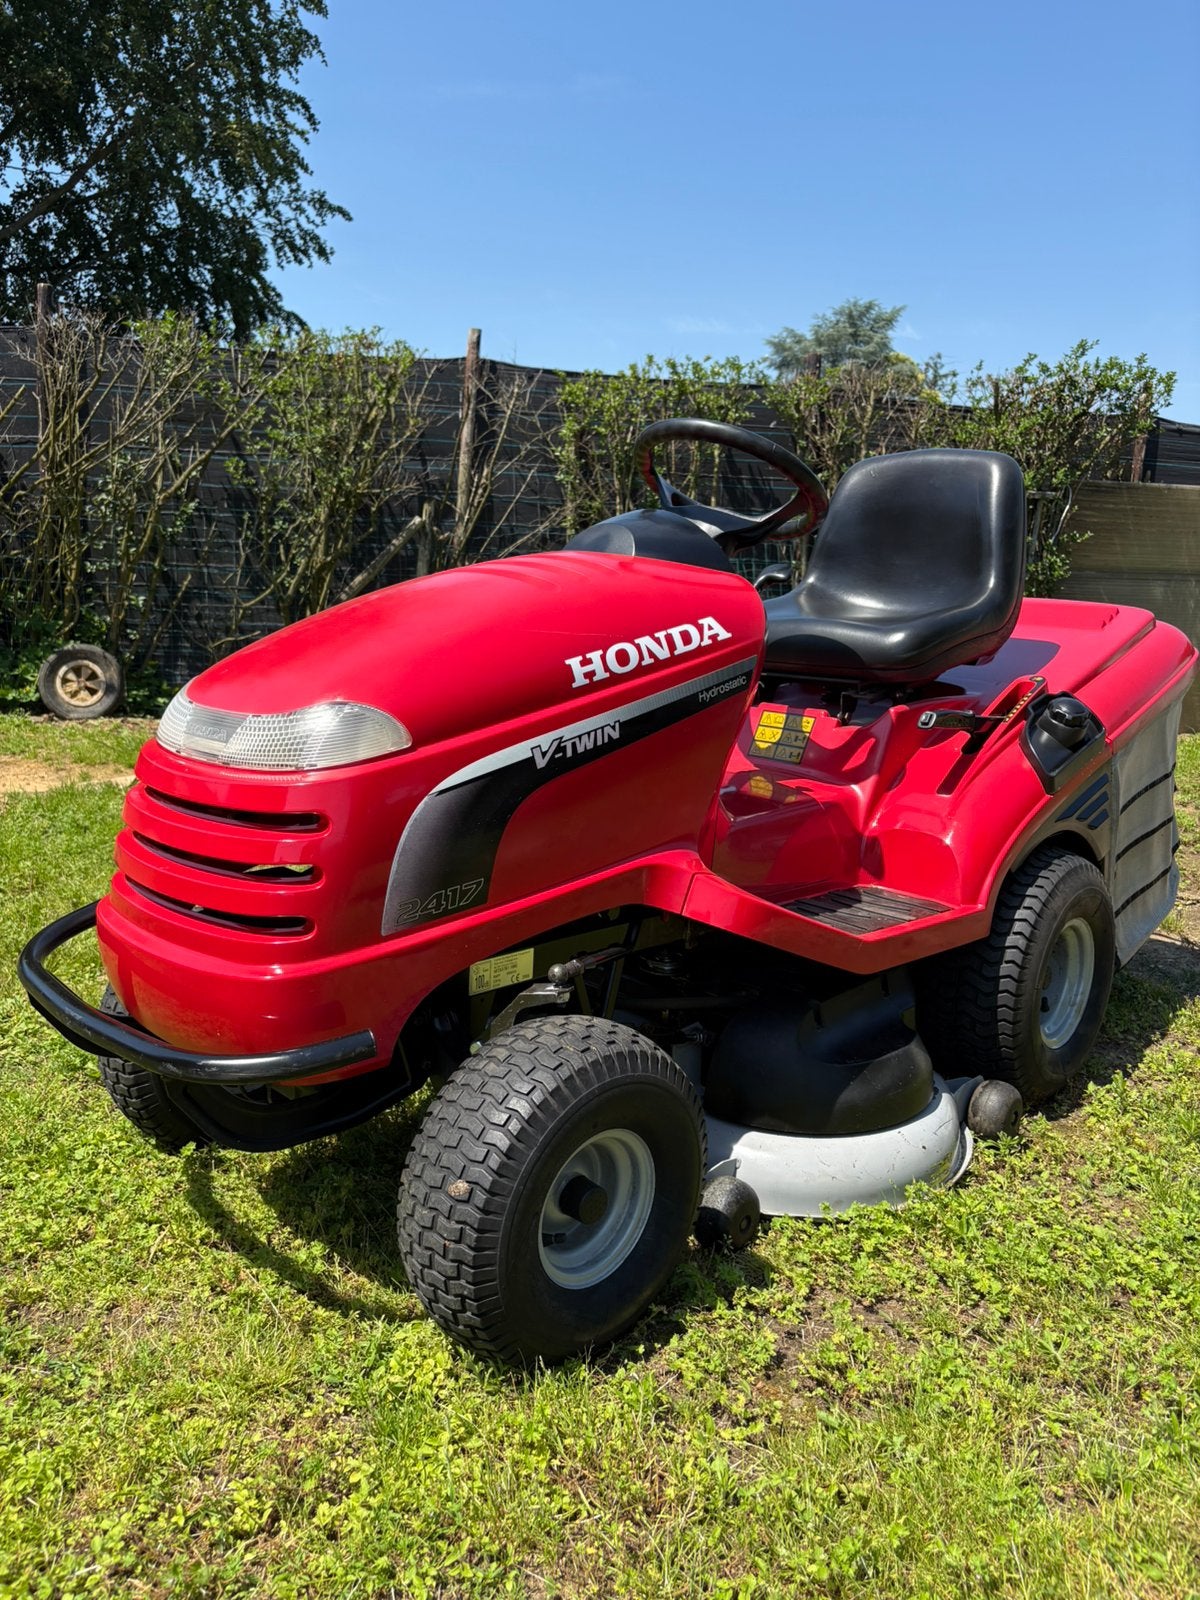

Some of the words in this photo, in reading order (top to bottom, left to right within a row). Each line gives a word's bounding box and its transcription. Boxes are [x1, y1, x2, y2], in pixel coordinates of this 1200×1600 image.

[565, 616, 733, 689] HONDA
[698, 675, 747, 703] Hydrostatic
[531, 720, 621, 770] V-TWIN
[396, 877, 485, 926] 2417
